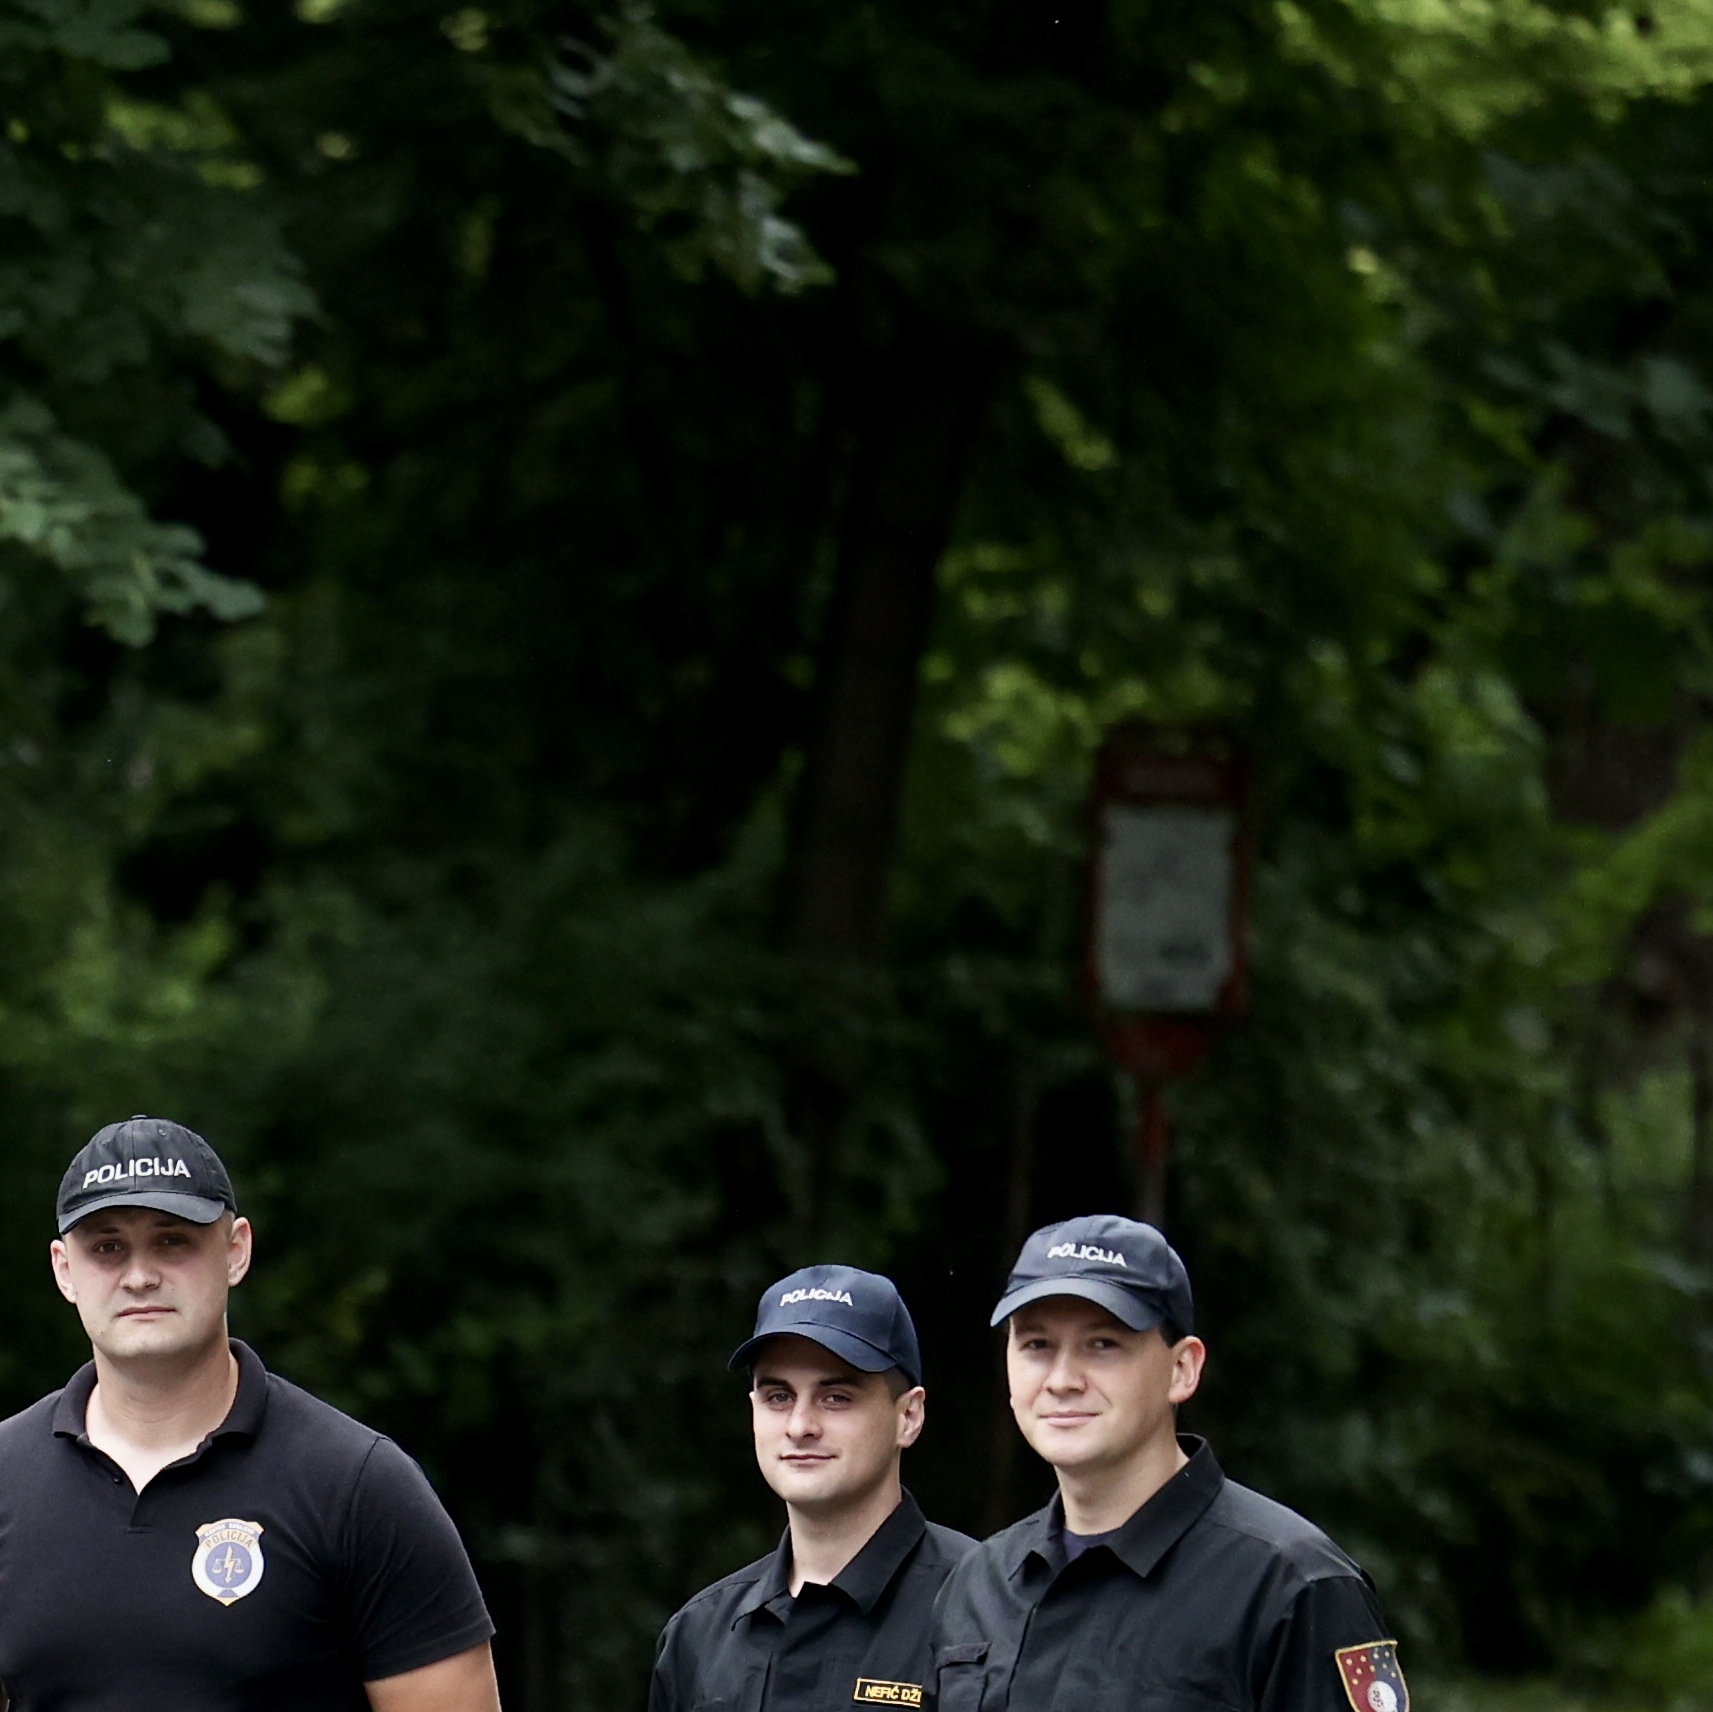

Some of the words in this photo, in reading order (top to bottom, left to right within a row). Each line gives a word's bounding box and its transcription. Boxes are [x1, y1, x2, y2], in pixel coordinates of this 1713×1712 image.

[82, 1157, 191, 1189] POLICIJA
[1047, 1242, 1127, 1267] POLICIJA
[779, 1288, 853, 1307] POLICIJA
[204, 1530, 254, 1549] POLICIJA
